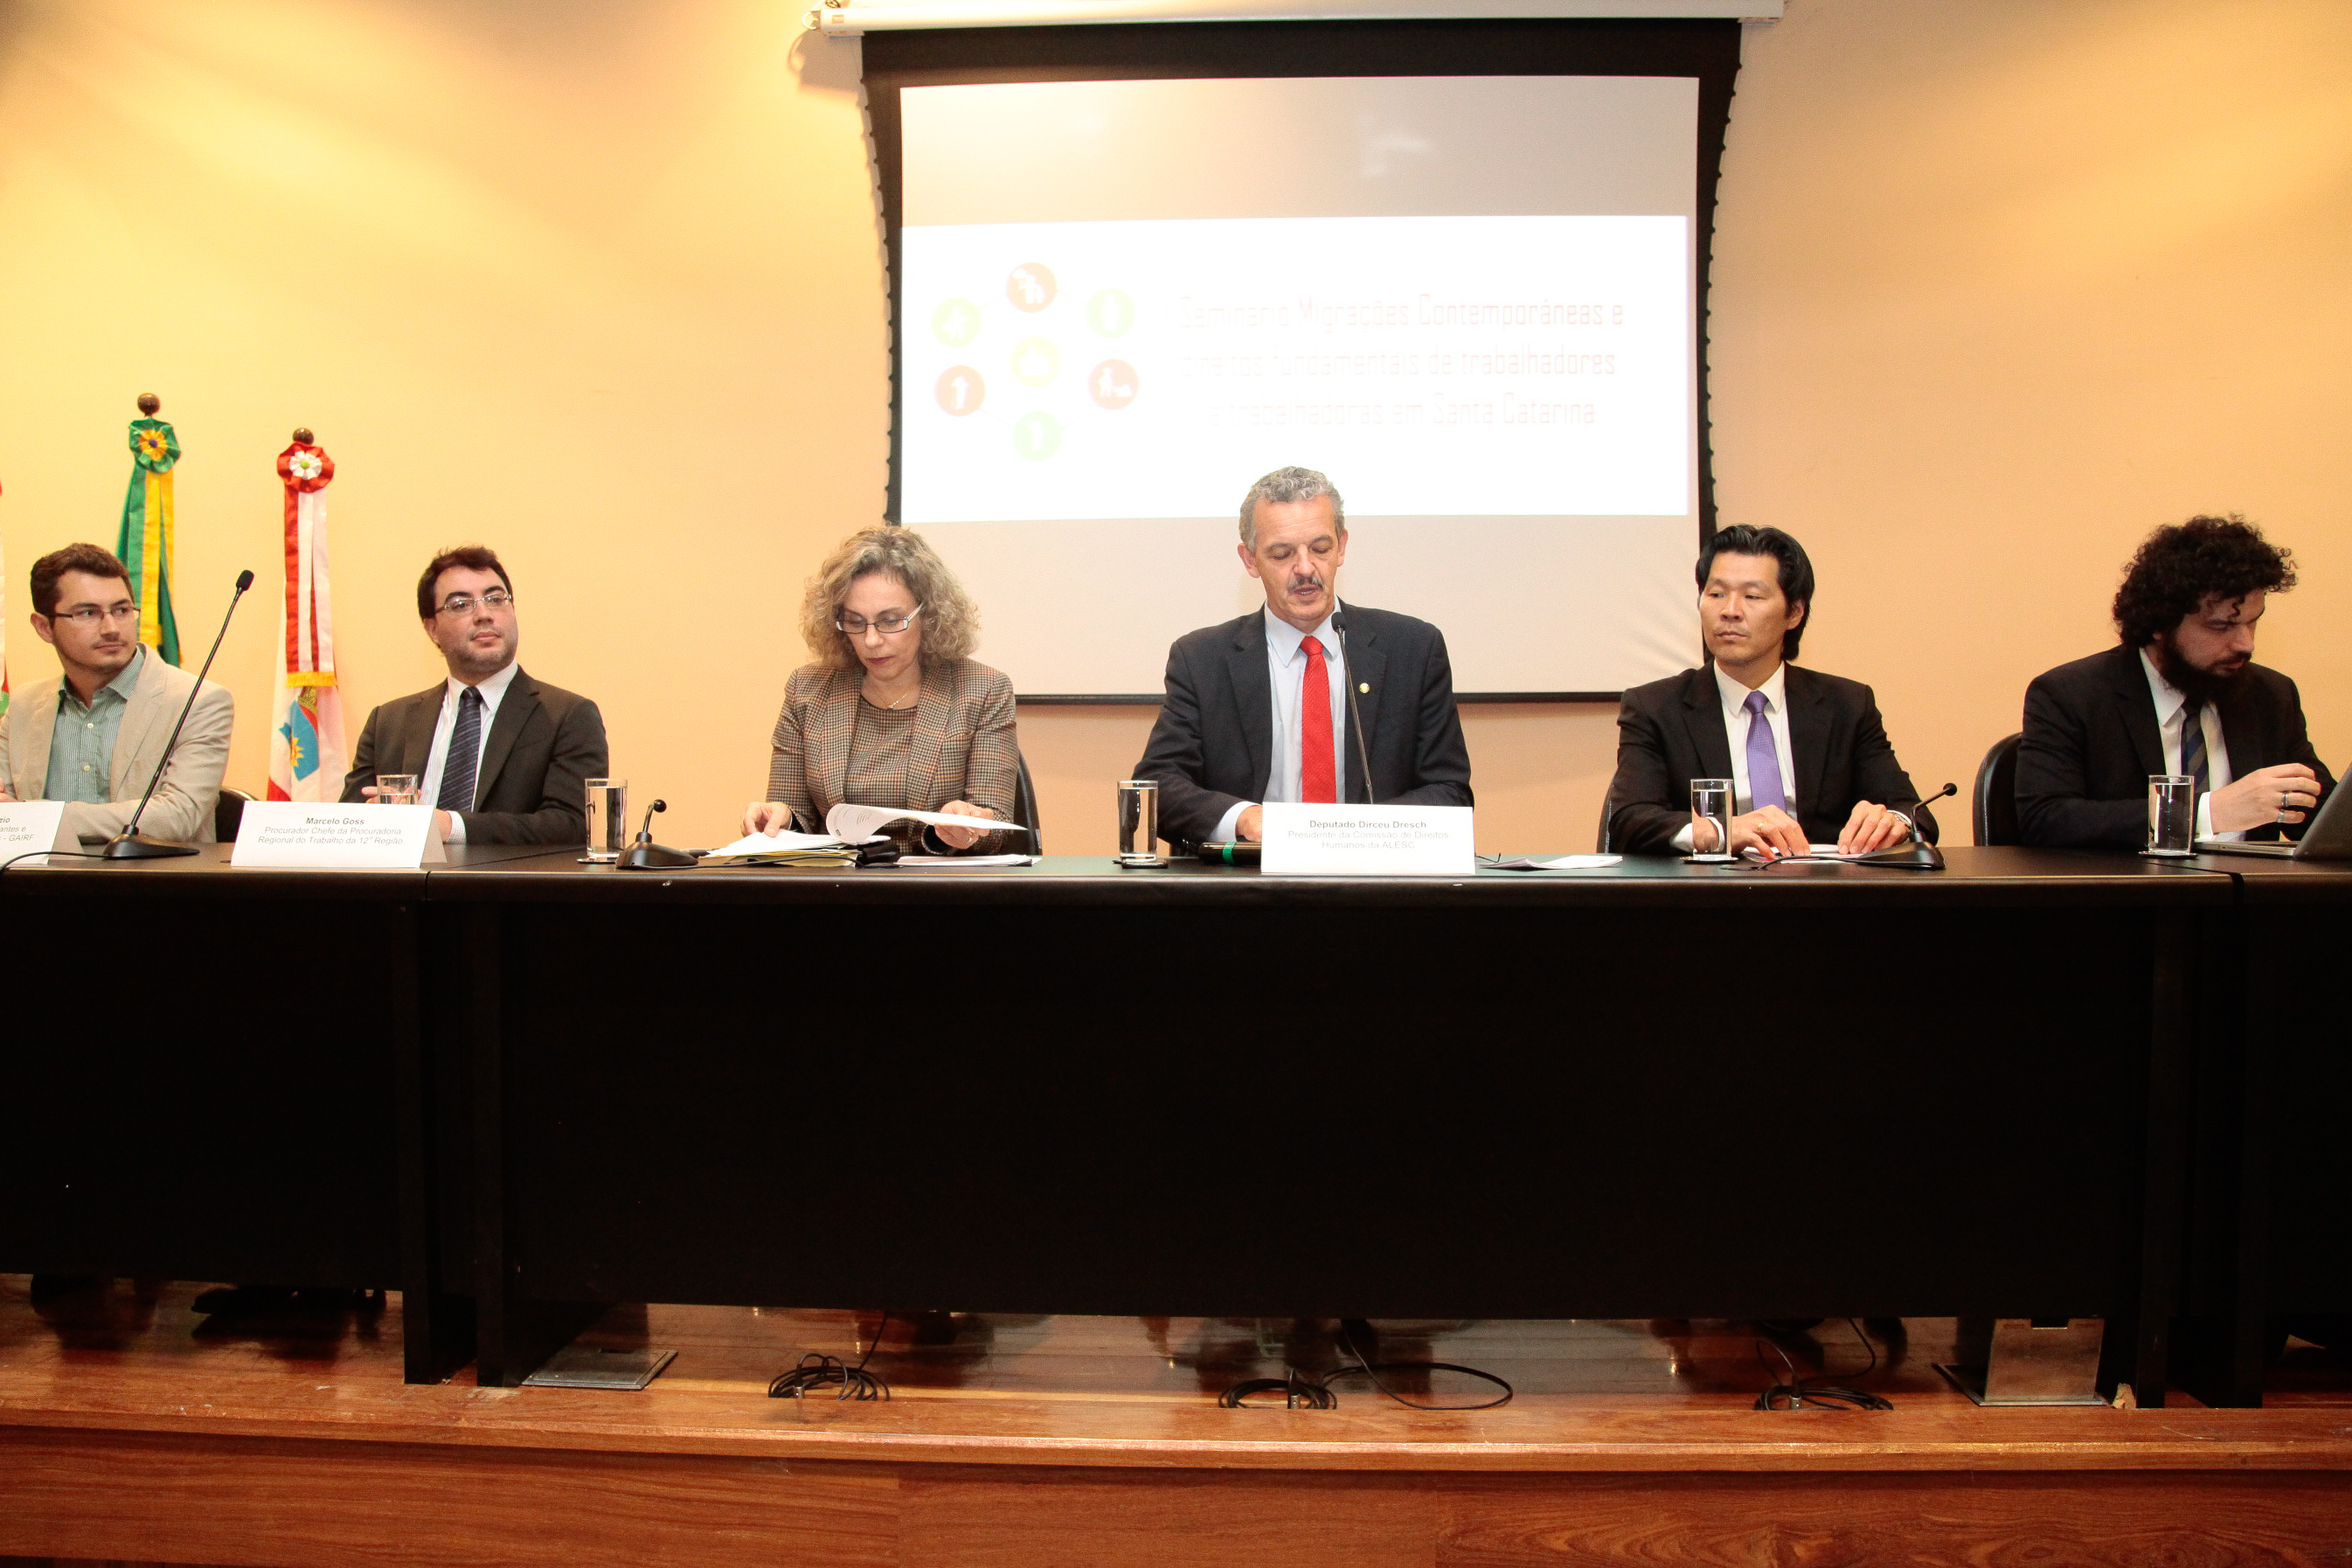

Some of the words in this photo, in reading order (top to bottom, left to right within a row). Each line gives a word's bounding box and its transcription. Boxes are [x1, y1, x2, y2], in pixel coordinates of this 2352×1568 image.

[1298, 293, 1410, 335] Migrações
[1419, 293, 1604, 331] Contemporâneas
[1612, 303, 1626, 325] e
[1272, 343, 1419, 377] fundamentais
[1429, 343, 1453, 375] de
[1461, 342, 1616, 375] trabalhadores
[1227, 392, 1383, 427] trabalhadoras
[1392, 403, 1424, 426] em
[1432, 391, 1495, 425] Santa
[1502, 391, 1596, 425] Catarina
[1309, 820, 1356, 829] Deputado
[265, 826, 309, 835] Procurador
[350, 827, 401, 836] Procuradoria
[1288, 830, 1336, 839] Presidente
[1339, 830, 1350, 839] da
[1353, 830, 1398, 839] Comissão
[1401, 830, 1412, 839] de
[1414, 830, 1449, 839] Direitos
[258, 836, 295, 844] Regional
[375, 836, 404, 845] Região
[1322, 841, 1365, 850] Humanos
[1368, 841, 1379, 850] da
[1382, 841, 1415, 850] ALESC
